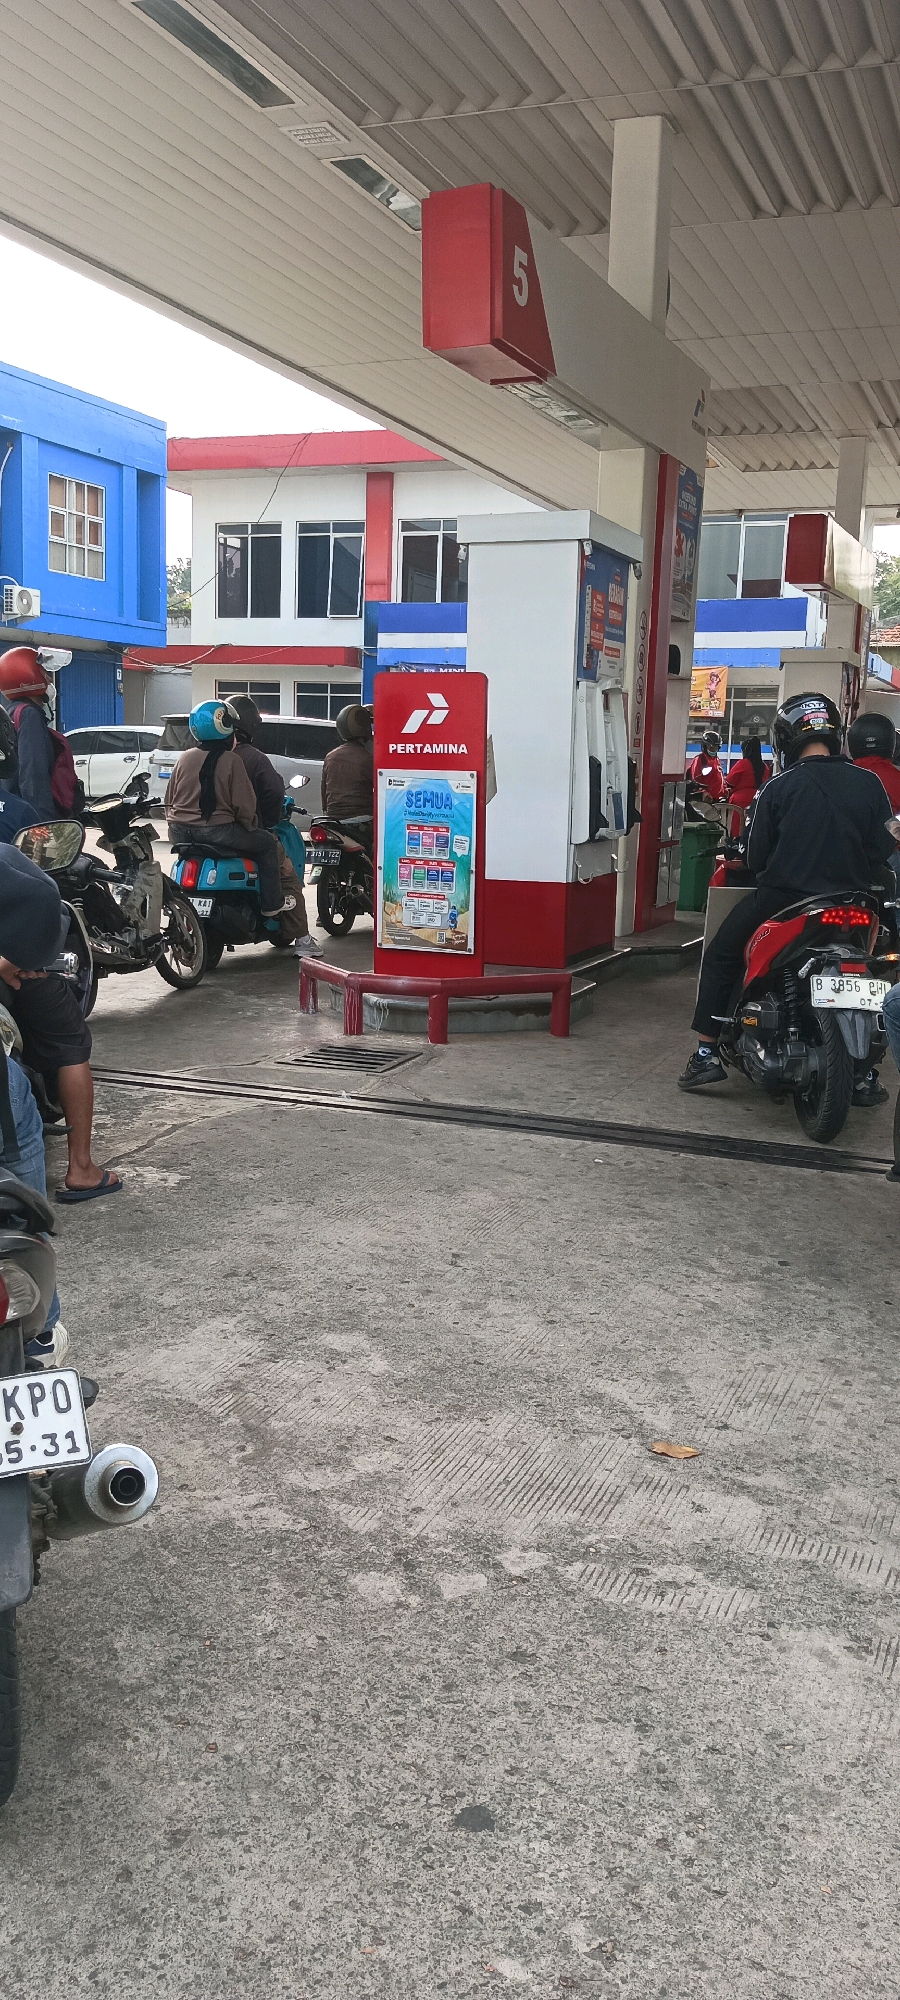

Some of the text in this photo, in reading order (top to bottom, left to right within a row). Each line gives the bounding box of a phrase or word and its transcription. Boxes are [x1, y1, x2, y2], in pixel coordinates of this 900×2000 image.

[512, 244, 529, 307] 5
[388, 743, 469, 755] PERTAMINA
[405, 790, 453, 810] SEMUA
[815, 978, 823, 991] B
[830, 978, 861, 993] 3856
[2, 1379, 72, 1422] KPO
